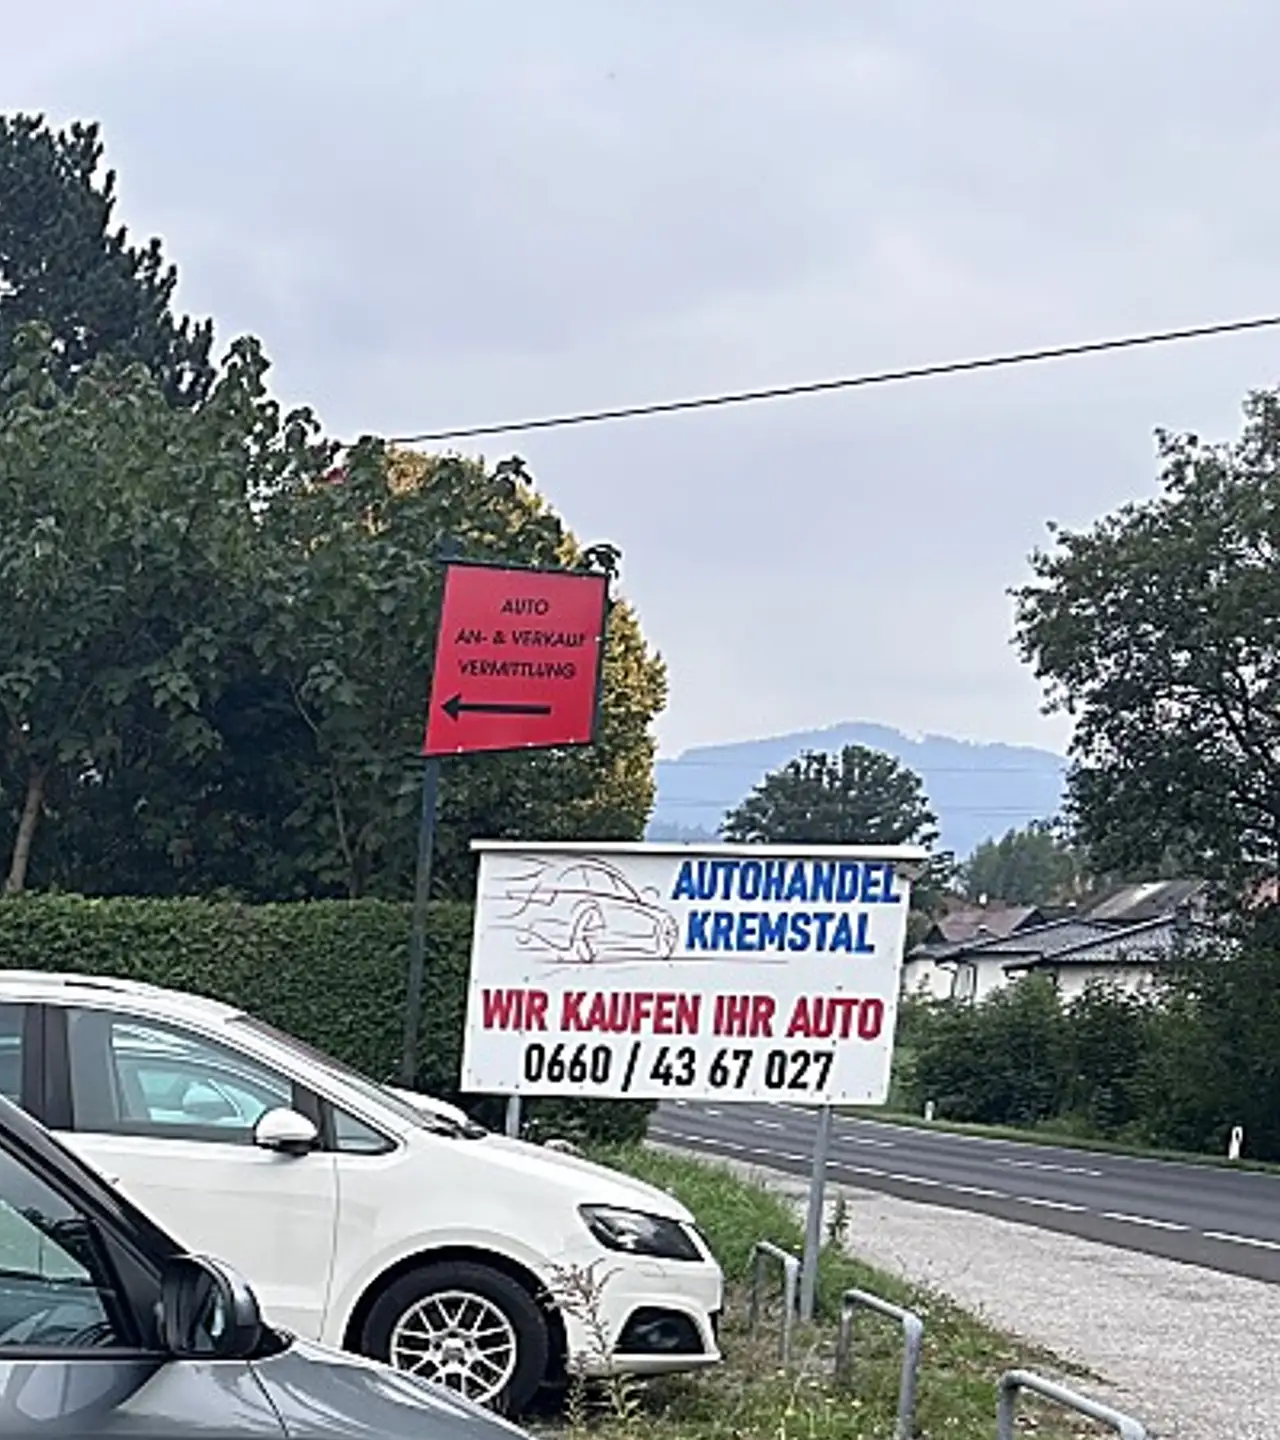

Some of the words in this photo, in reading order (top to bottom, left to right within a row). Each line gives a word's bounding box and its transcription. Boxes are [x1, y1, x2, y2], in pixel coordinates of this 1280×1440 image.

[501, 598, 550, 615] AUTO
[455, 628, 488, 645] AN-
[492, 630, 506, 645] &
[512, 630, 586, 648] VERKAUF
[458, 659, 577, 680] VERMITTLUNG
[671, 860, 901, 903] AUTOHANDEL
[686, 910, 875, 953] KREMSTAL
[481, 989, 549, 1032] WIR
[561, 991, 701, 1036] KAUFEN
[714, 994, 776, 1038] IHR
[785, 996, 884, 1040] AUTO
[524, 1043, 612, 1083] 0660
[621, 1041, 641, 1092] /
[650, 1046, 696, 1087] 43
[708, 1048, 754, 1090] 67
[764, 1049, 834, 1091] 027
